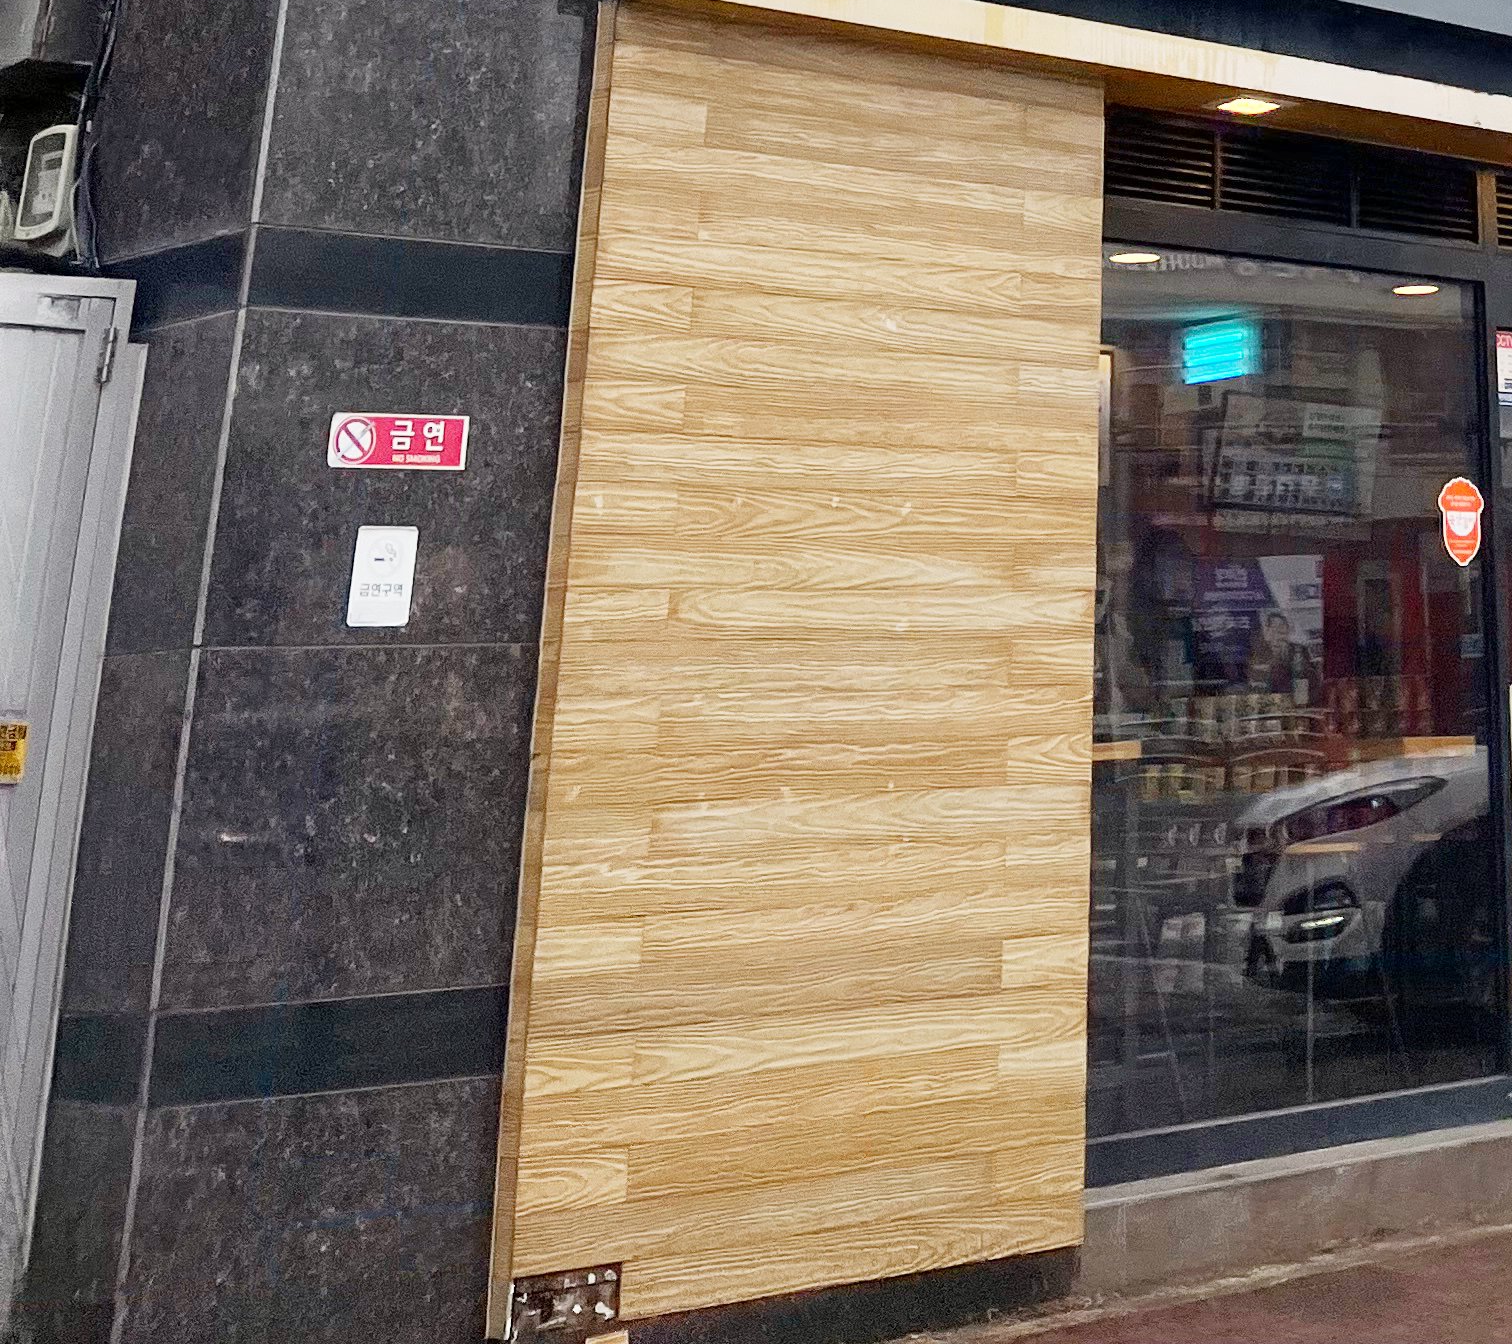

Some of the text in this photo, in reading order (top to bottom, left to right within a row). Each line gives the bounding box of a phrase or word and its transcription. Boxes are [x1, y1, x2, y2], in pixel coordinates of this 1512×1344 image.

[390, 419, 445, 452] 금연
[391, 453, 441, 465] NO SMOKING
[359, 583, 404, 598] 금연구역
